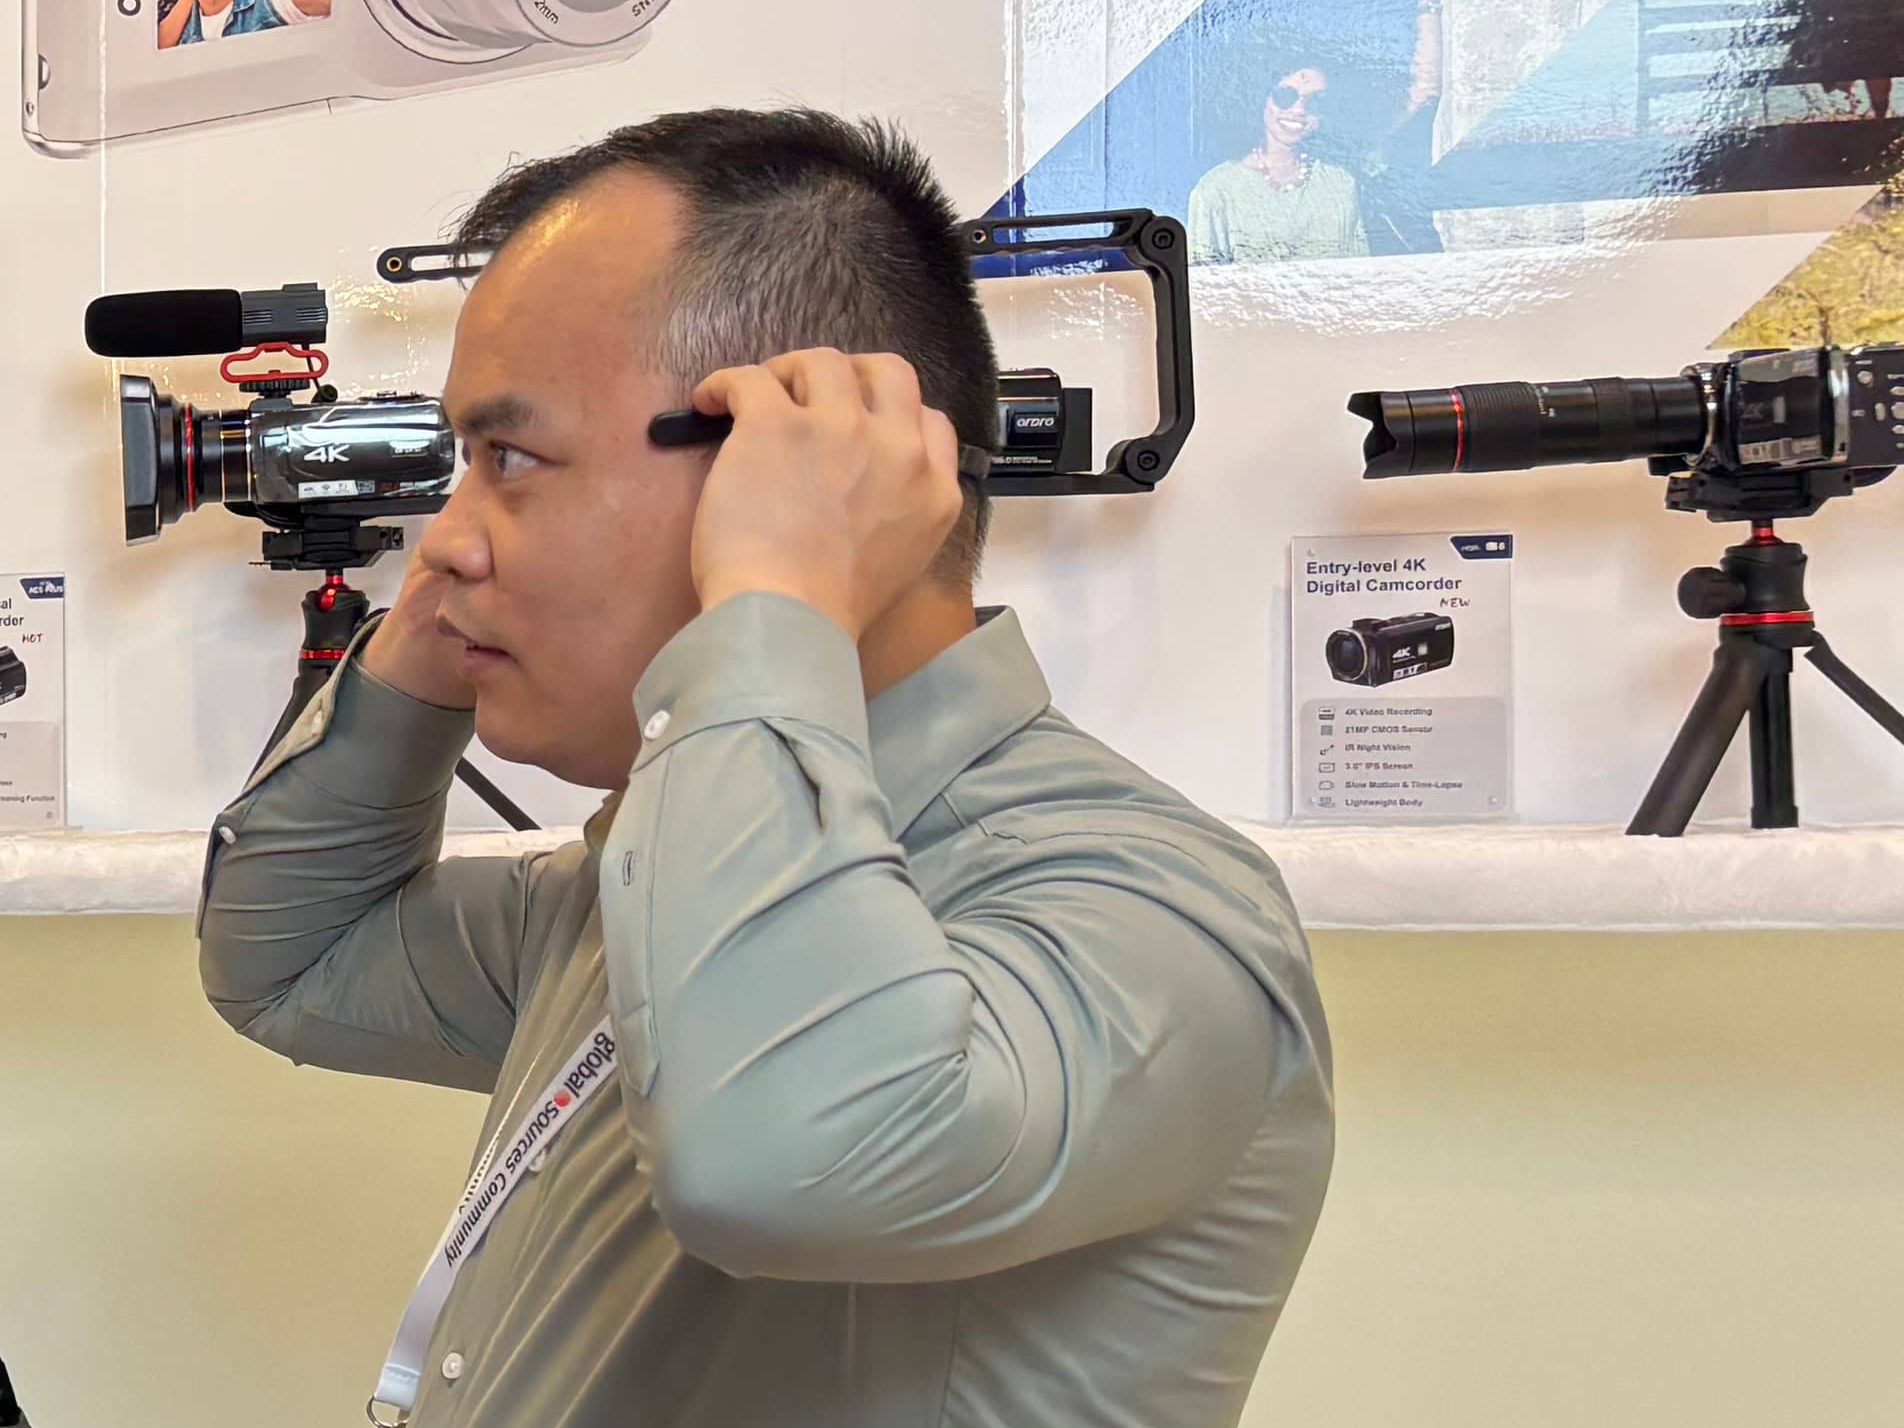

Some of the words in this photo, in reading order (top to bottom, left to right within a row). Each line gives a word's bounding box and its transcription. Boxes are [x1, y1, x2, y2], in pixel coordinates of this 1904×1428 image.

[303, 444, 351, 463] 4K
[1306, 559, 1398, 577] Entry-level
[1402, 558, 1427, 572] 4K
[1306, 579, 1361, 596] Digital
[1365, 577, 1463, 593] Camcorder
[564, 1031, 615, 1099] global
[506, 1099, 560, 1175] sources
[445, 1172, 507, 1268] Community
